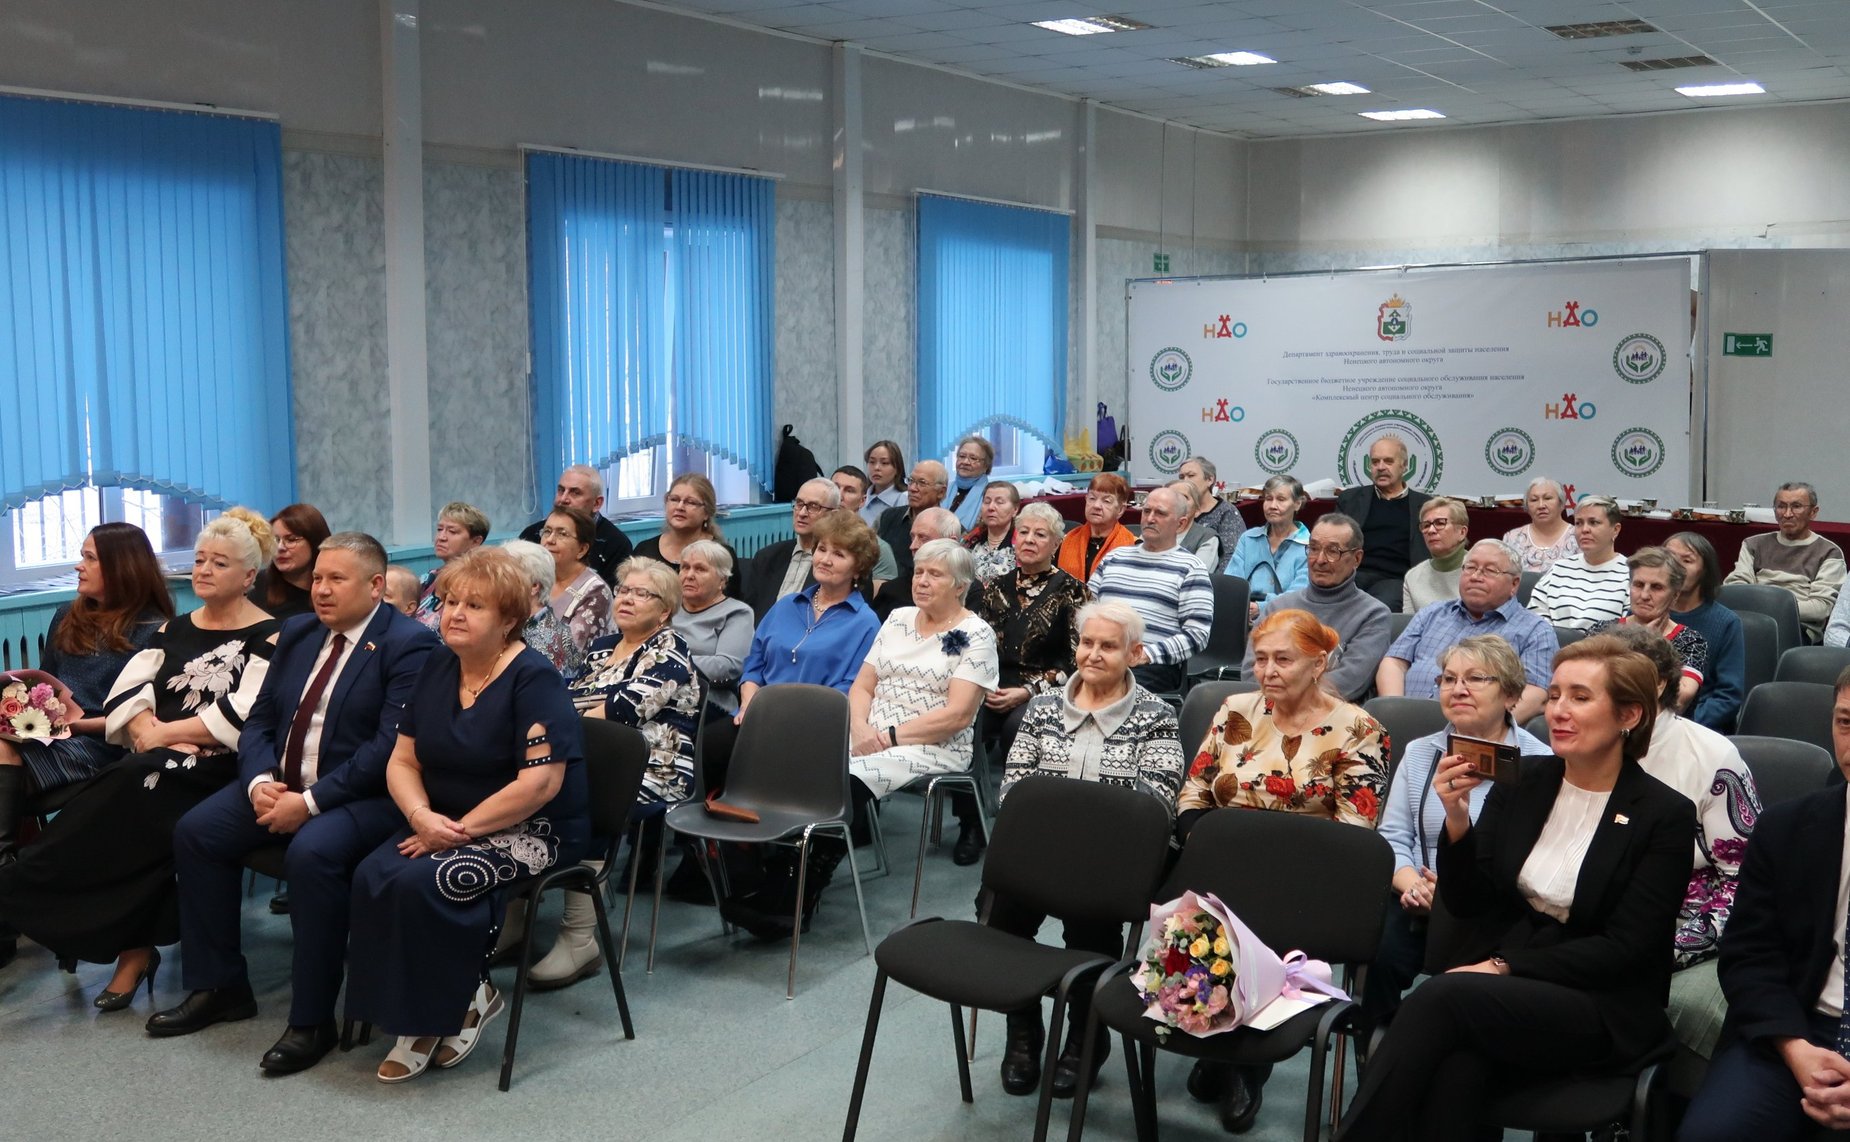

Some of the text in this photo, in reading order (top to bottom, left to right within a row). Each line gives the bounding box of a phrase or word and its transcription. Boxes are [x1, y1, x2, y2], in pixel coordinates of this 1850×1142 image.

[1282, 351, 1323, 359] Департамент
[1407, 347, 1446, 355] социальной
[1267, 378, 1319, 386] Государственное
[1320, 376, 1356, 385] бюджетное
[1440, 375, 1488, 383] обслуживания
[1420, 384, 1443, 392] округа
[1311, 393, 1359, 401] «Комплексный
